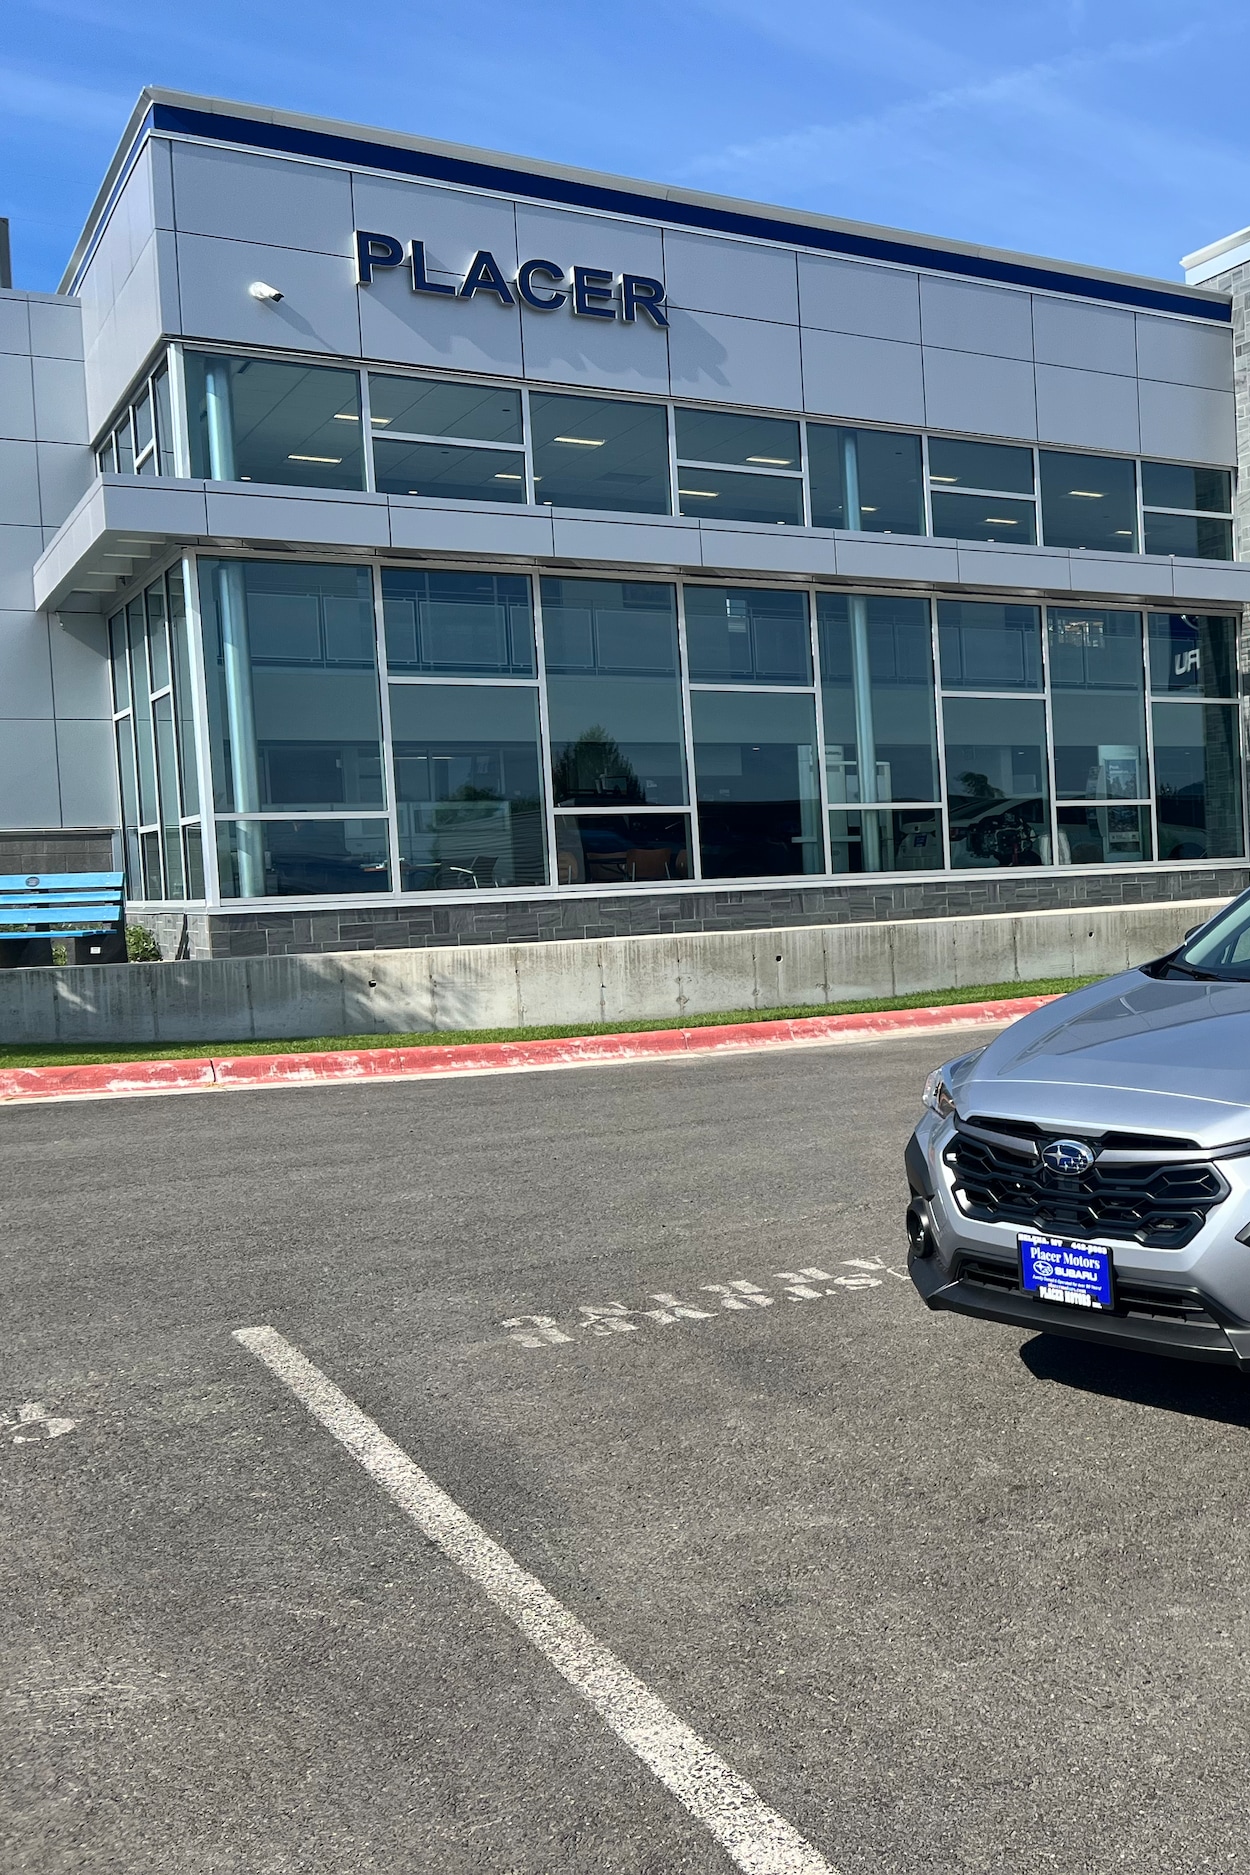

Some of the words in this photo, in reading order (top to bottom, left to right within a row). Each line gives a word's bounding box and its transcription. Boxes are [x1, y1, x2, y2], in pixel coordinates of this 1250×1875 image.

[354, 229, 670, 328] PLACER
[501, 1256, 888, 1328] ARKING
[1030, 1247, 1061, 1263] Placer
[1063, 1252, 1101, 1269] Motors
[1054, 1267, 1097, 1281] SUBARU
[507, 1265, 910, 1348] STOMER
